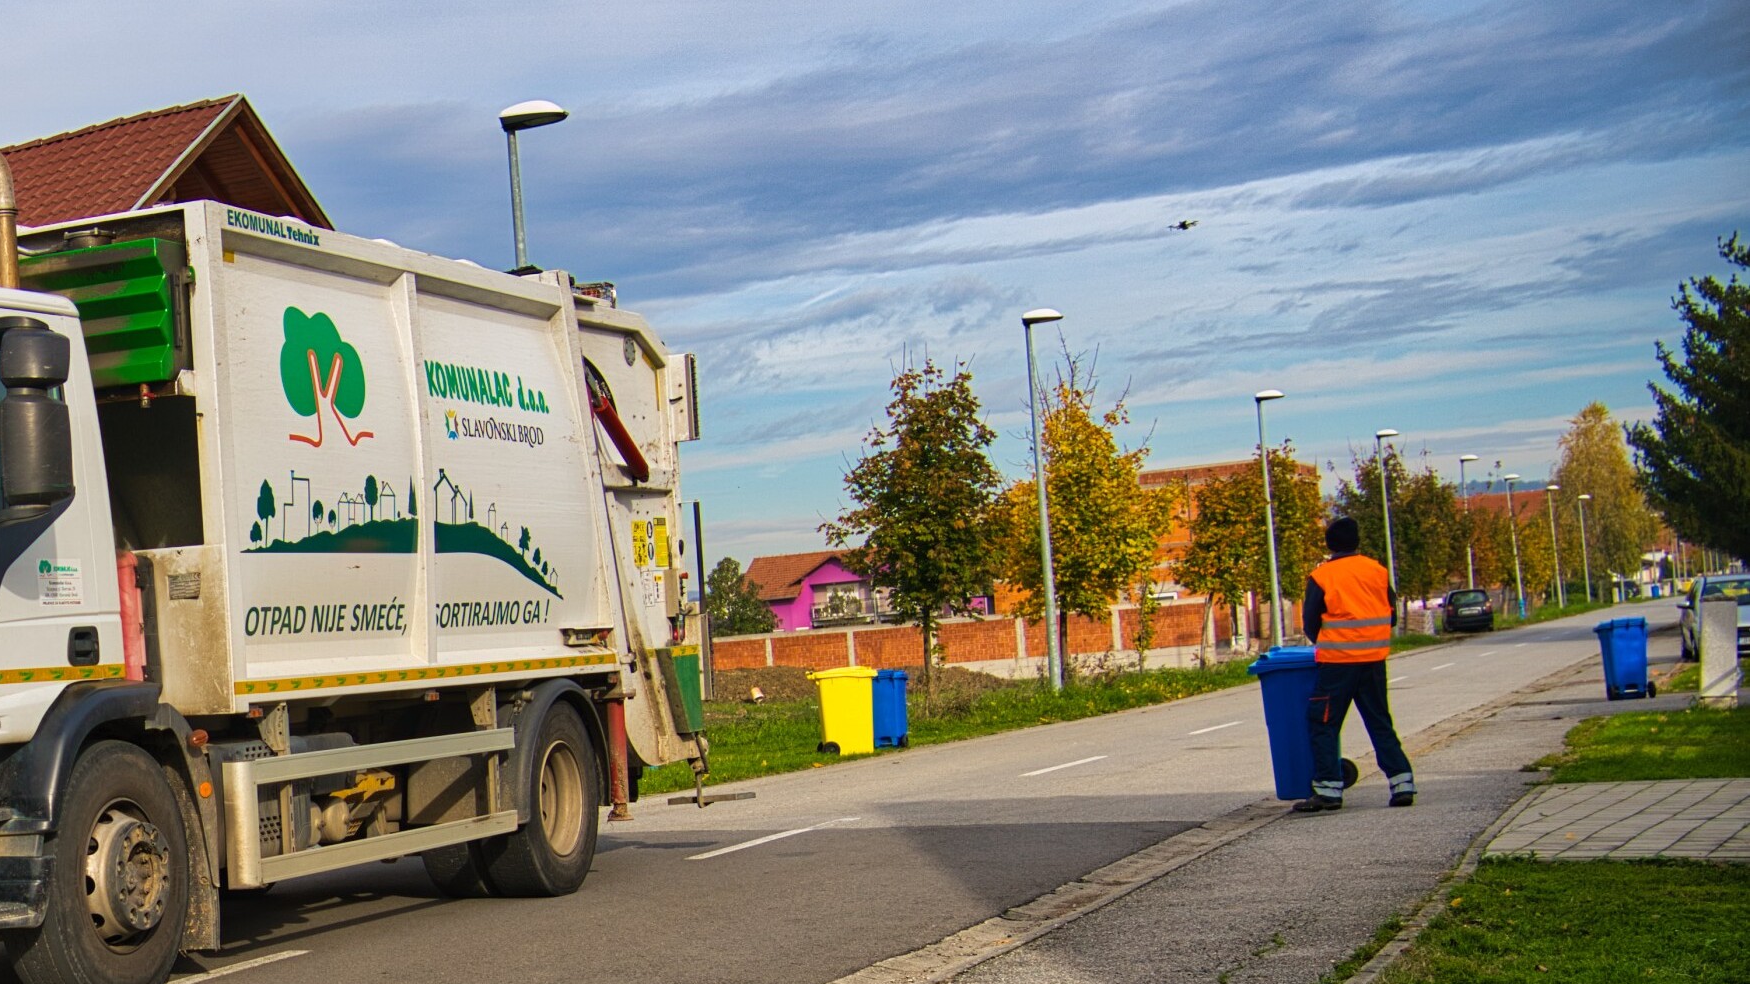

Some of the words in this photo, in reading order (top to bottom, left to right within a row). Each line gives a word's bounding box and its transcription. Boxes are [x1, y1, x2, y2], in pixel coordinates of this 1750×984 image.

[227, 209, 286, 239] EKOMUNAL
[424, 360, 513, 408] KOMUNALAC
[517, 375, 550, 414] d.o.o.
[461, 417, 516, 442] SLAVONSKI
[517, 424, 544, 448] BROD
[245, 607, 306, 636] OTPAD
[311, 605, 346, 633] NIJE
[350, 597, 407, 635] SMEĆE,
[523, 600, 541, 624] GA
